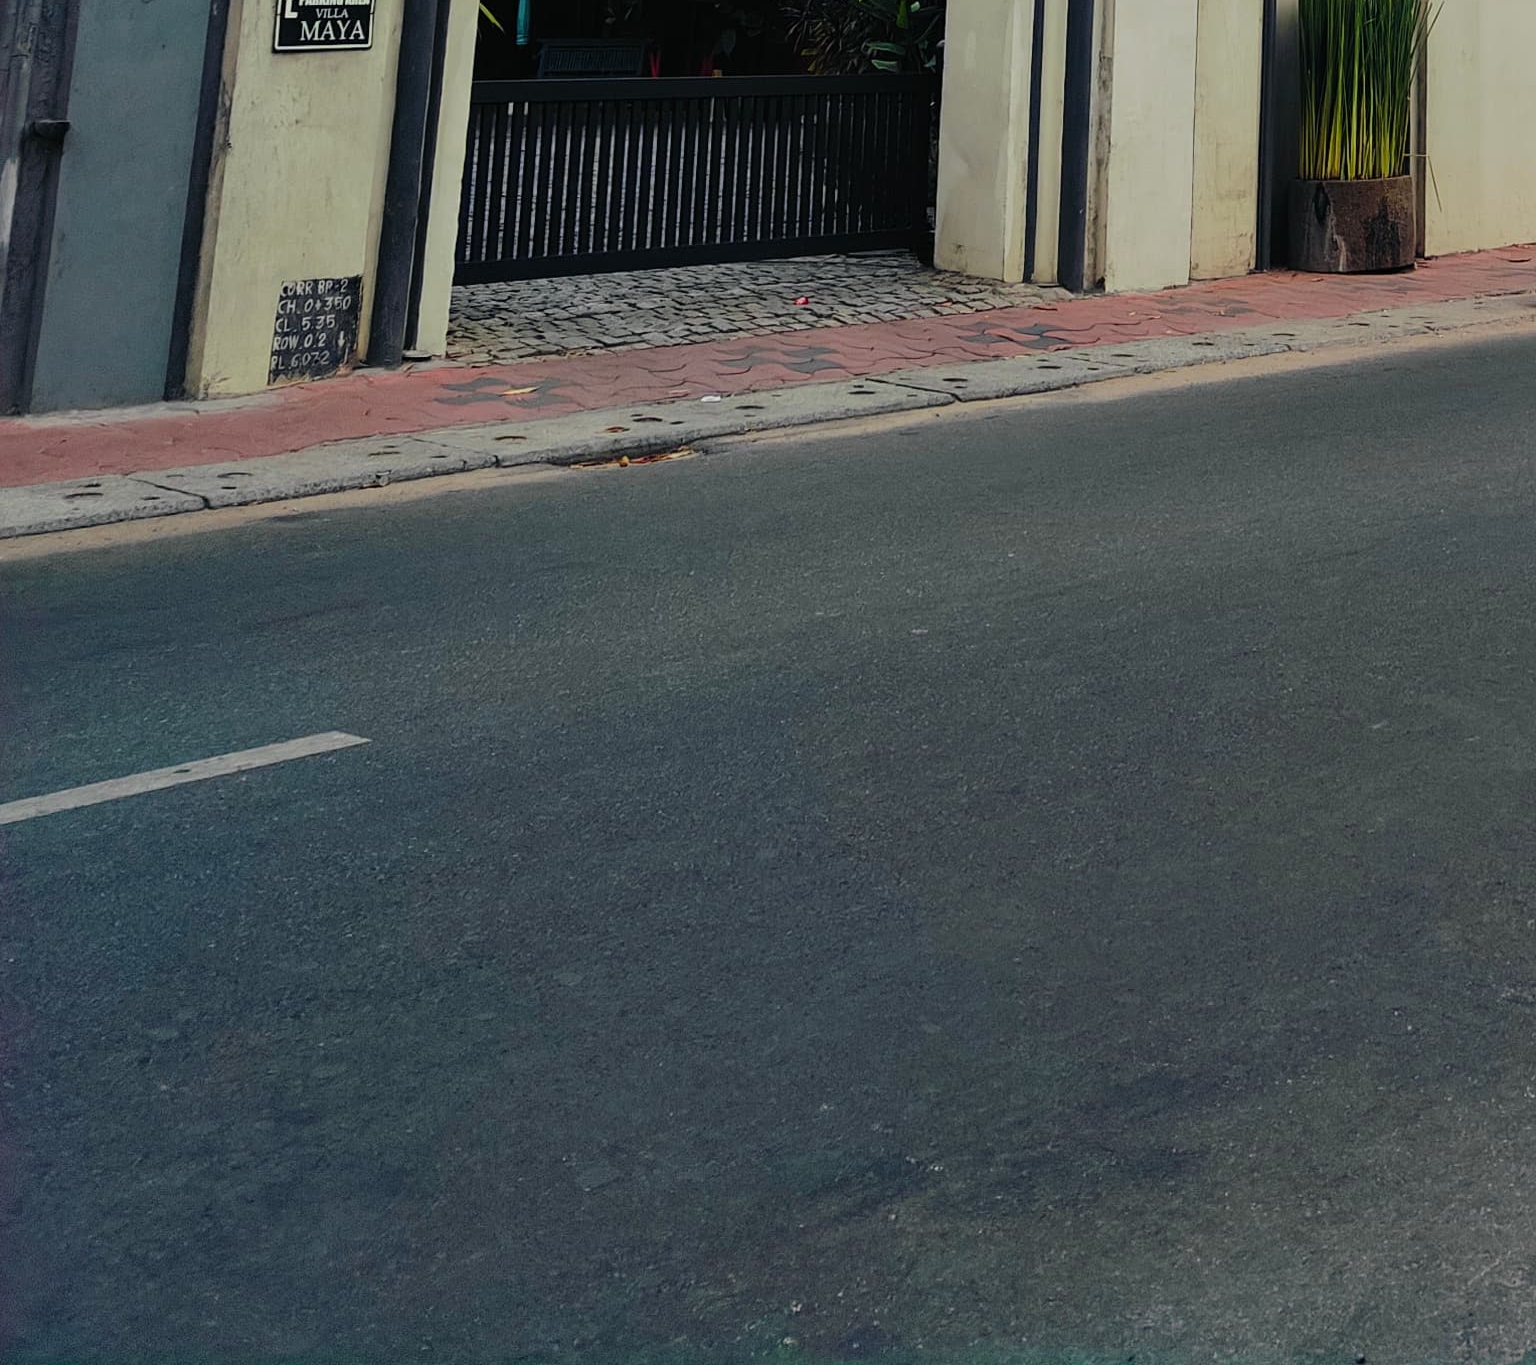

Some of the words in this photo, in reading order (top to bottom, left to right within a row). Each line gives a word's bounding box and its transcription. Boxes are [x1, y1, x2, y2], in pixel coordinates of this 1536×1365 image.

[315, 8, 349, 19] VILLA
[300, 20, 365, 41] MAYA
[281, 281, 313, 297] CORR
